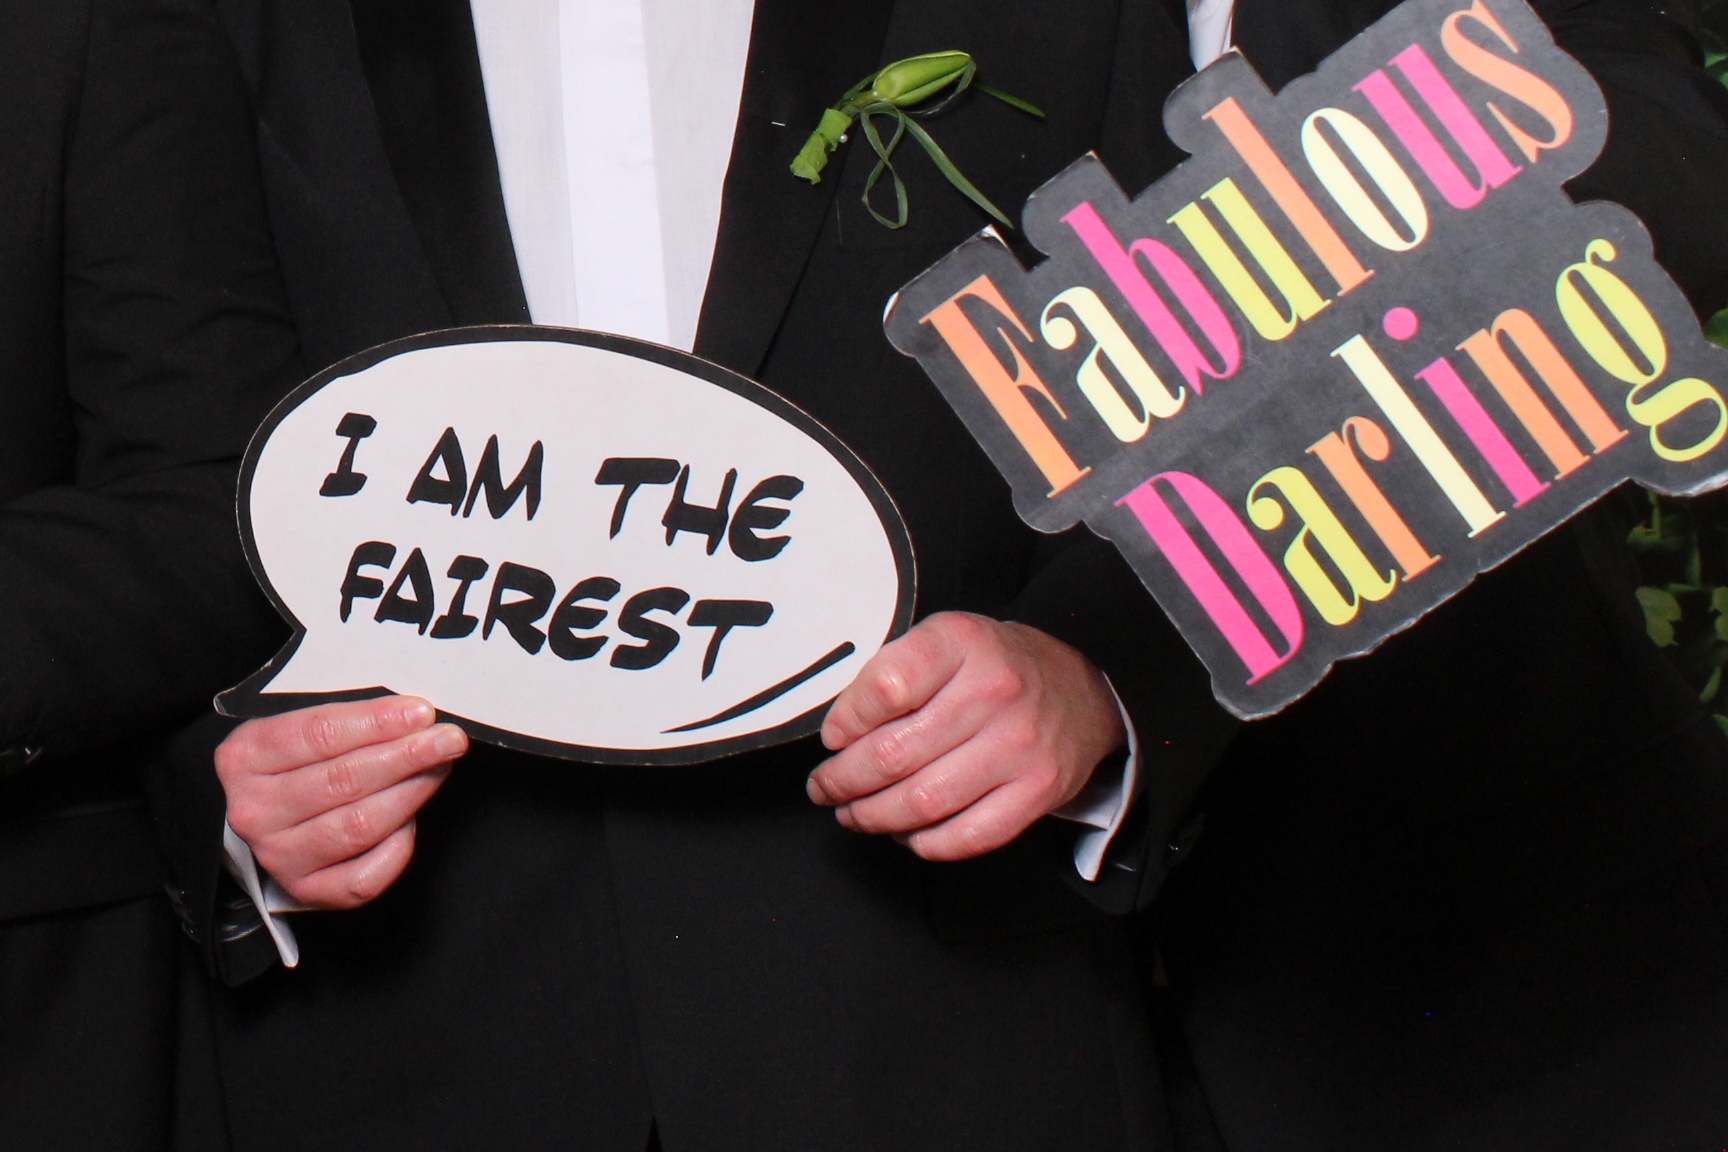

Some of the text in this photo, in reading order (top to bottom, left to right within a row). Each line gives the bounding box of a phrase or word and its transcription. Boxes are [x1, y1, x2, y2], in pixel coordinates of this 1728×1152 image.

[318, 411, 805, 563] I AM THE
[1115, 238, 1728, 687] Darling
[338, 540, 775, 682] FAIREST
